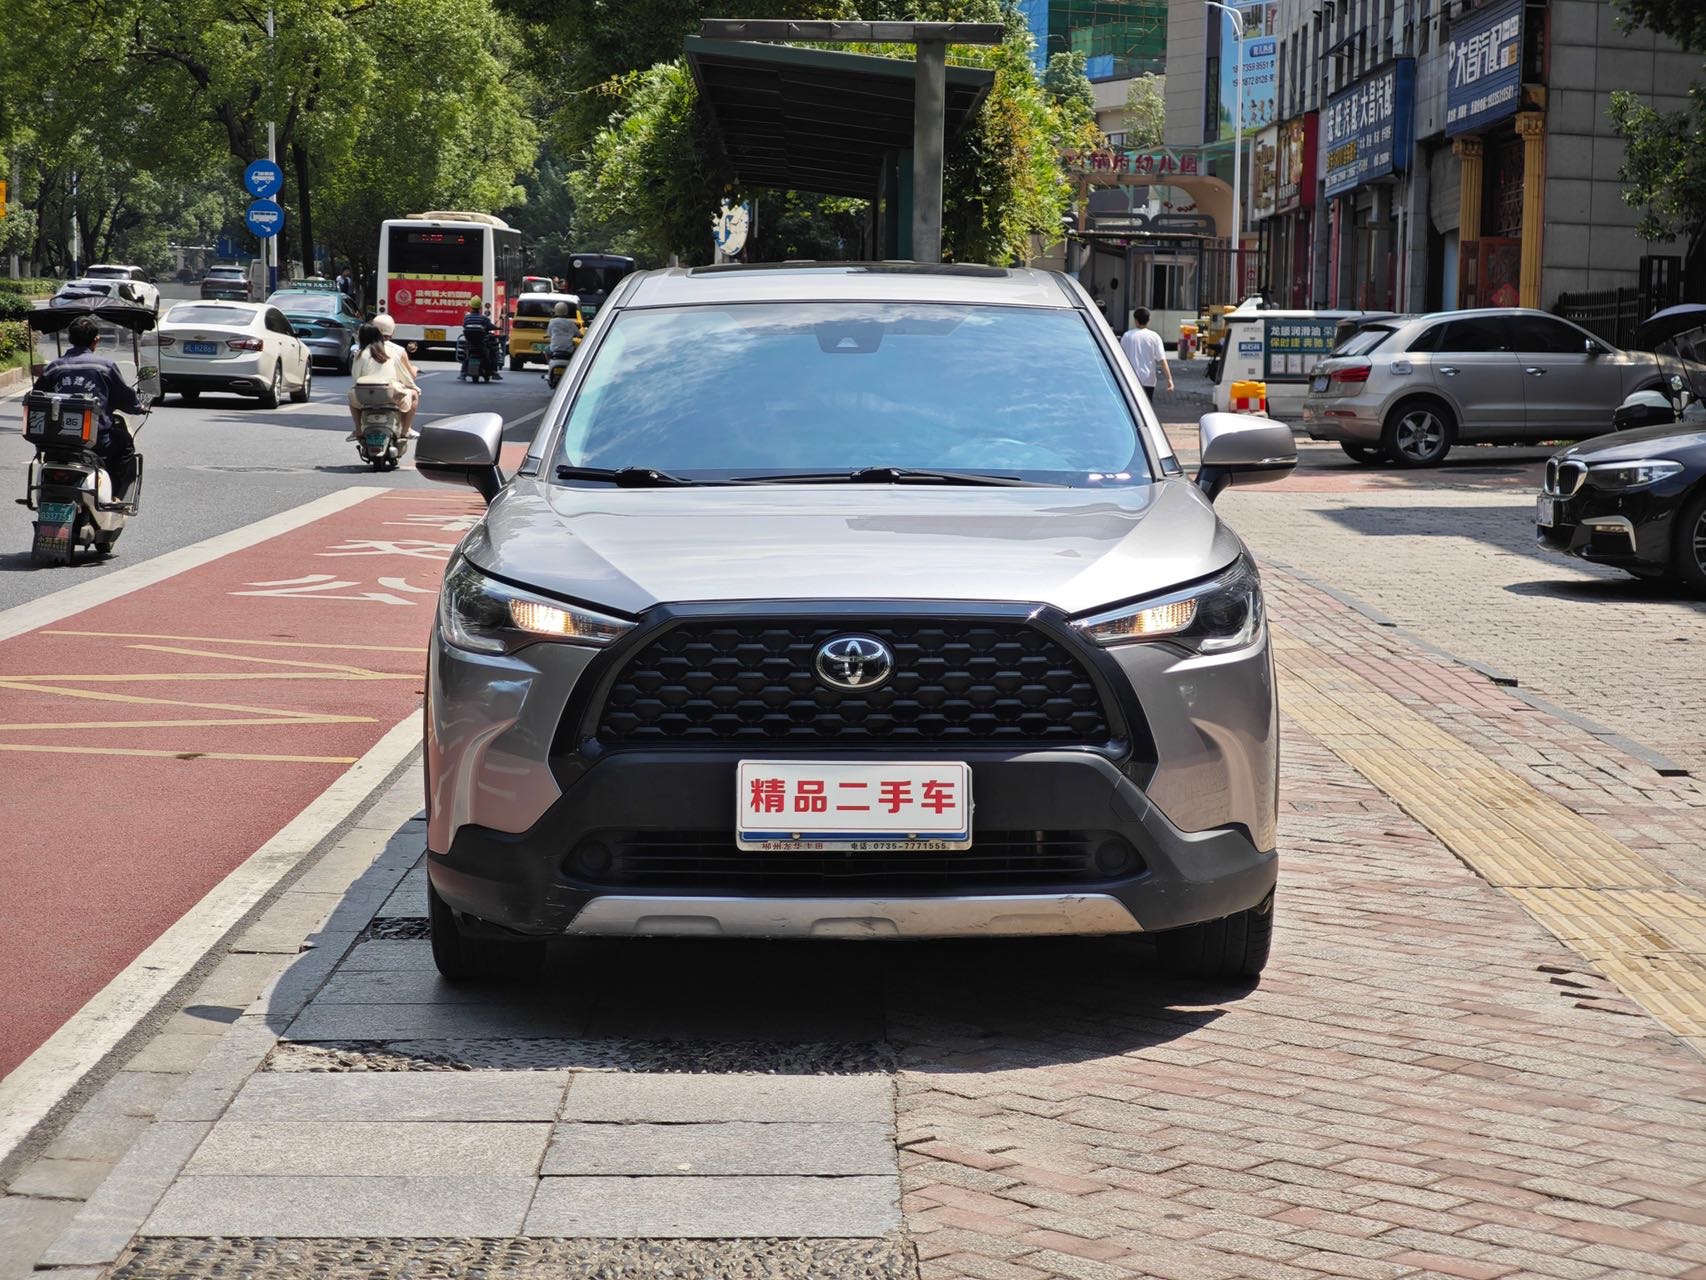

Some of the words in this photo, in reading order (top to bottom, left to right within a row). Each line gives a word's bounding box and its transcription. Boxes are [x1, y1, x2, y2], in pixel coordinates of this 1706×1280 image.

[1455, 22, 1502, 89] 大昌汽配
[1359, 73, 1392, 128] 大昌汽配
[1270, 337, 1300, 348] 保时捷
[750, 778, 956, 814] 精品二手车
